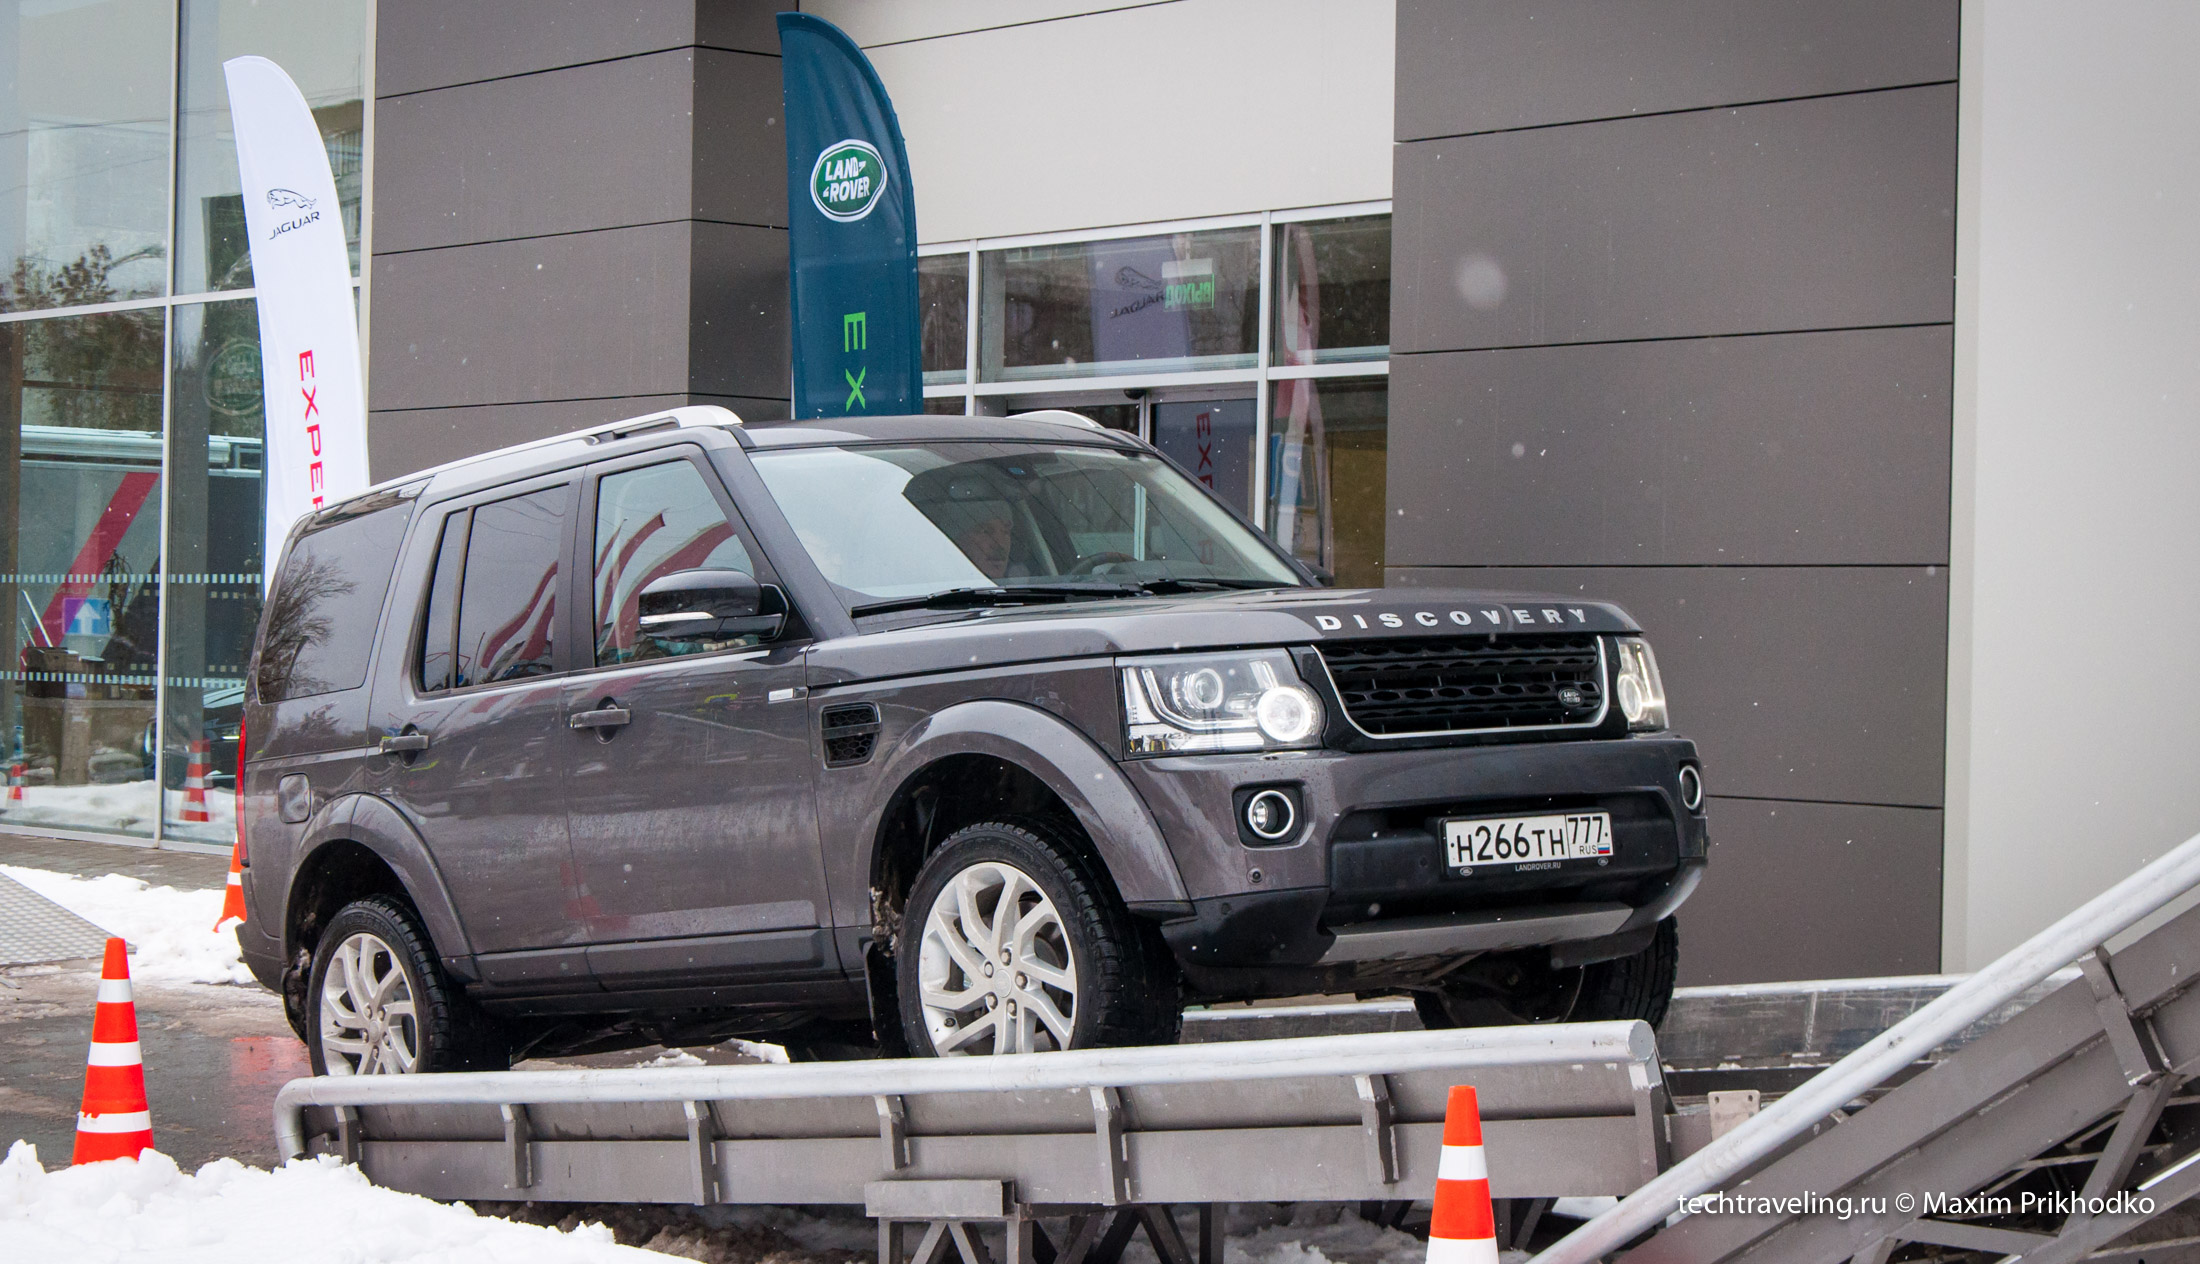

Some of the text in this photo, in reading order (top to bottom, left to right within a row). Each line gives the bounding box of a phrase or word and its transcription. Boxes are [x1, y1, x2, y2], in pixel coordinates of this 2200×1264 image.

[825, 157, 861, 181] LAND
[829, 176, 870, 203] ROVER
[269, 211, 320, 240] JAGUAR
[1315, 608, 1587, 631] DISCOVERY
[1568, 816, 1603, 845] 777
[1579, 844, 1597, 856] RUS
[1515, 862, 1562, 873] LANDROVER.RU
